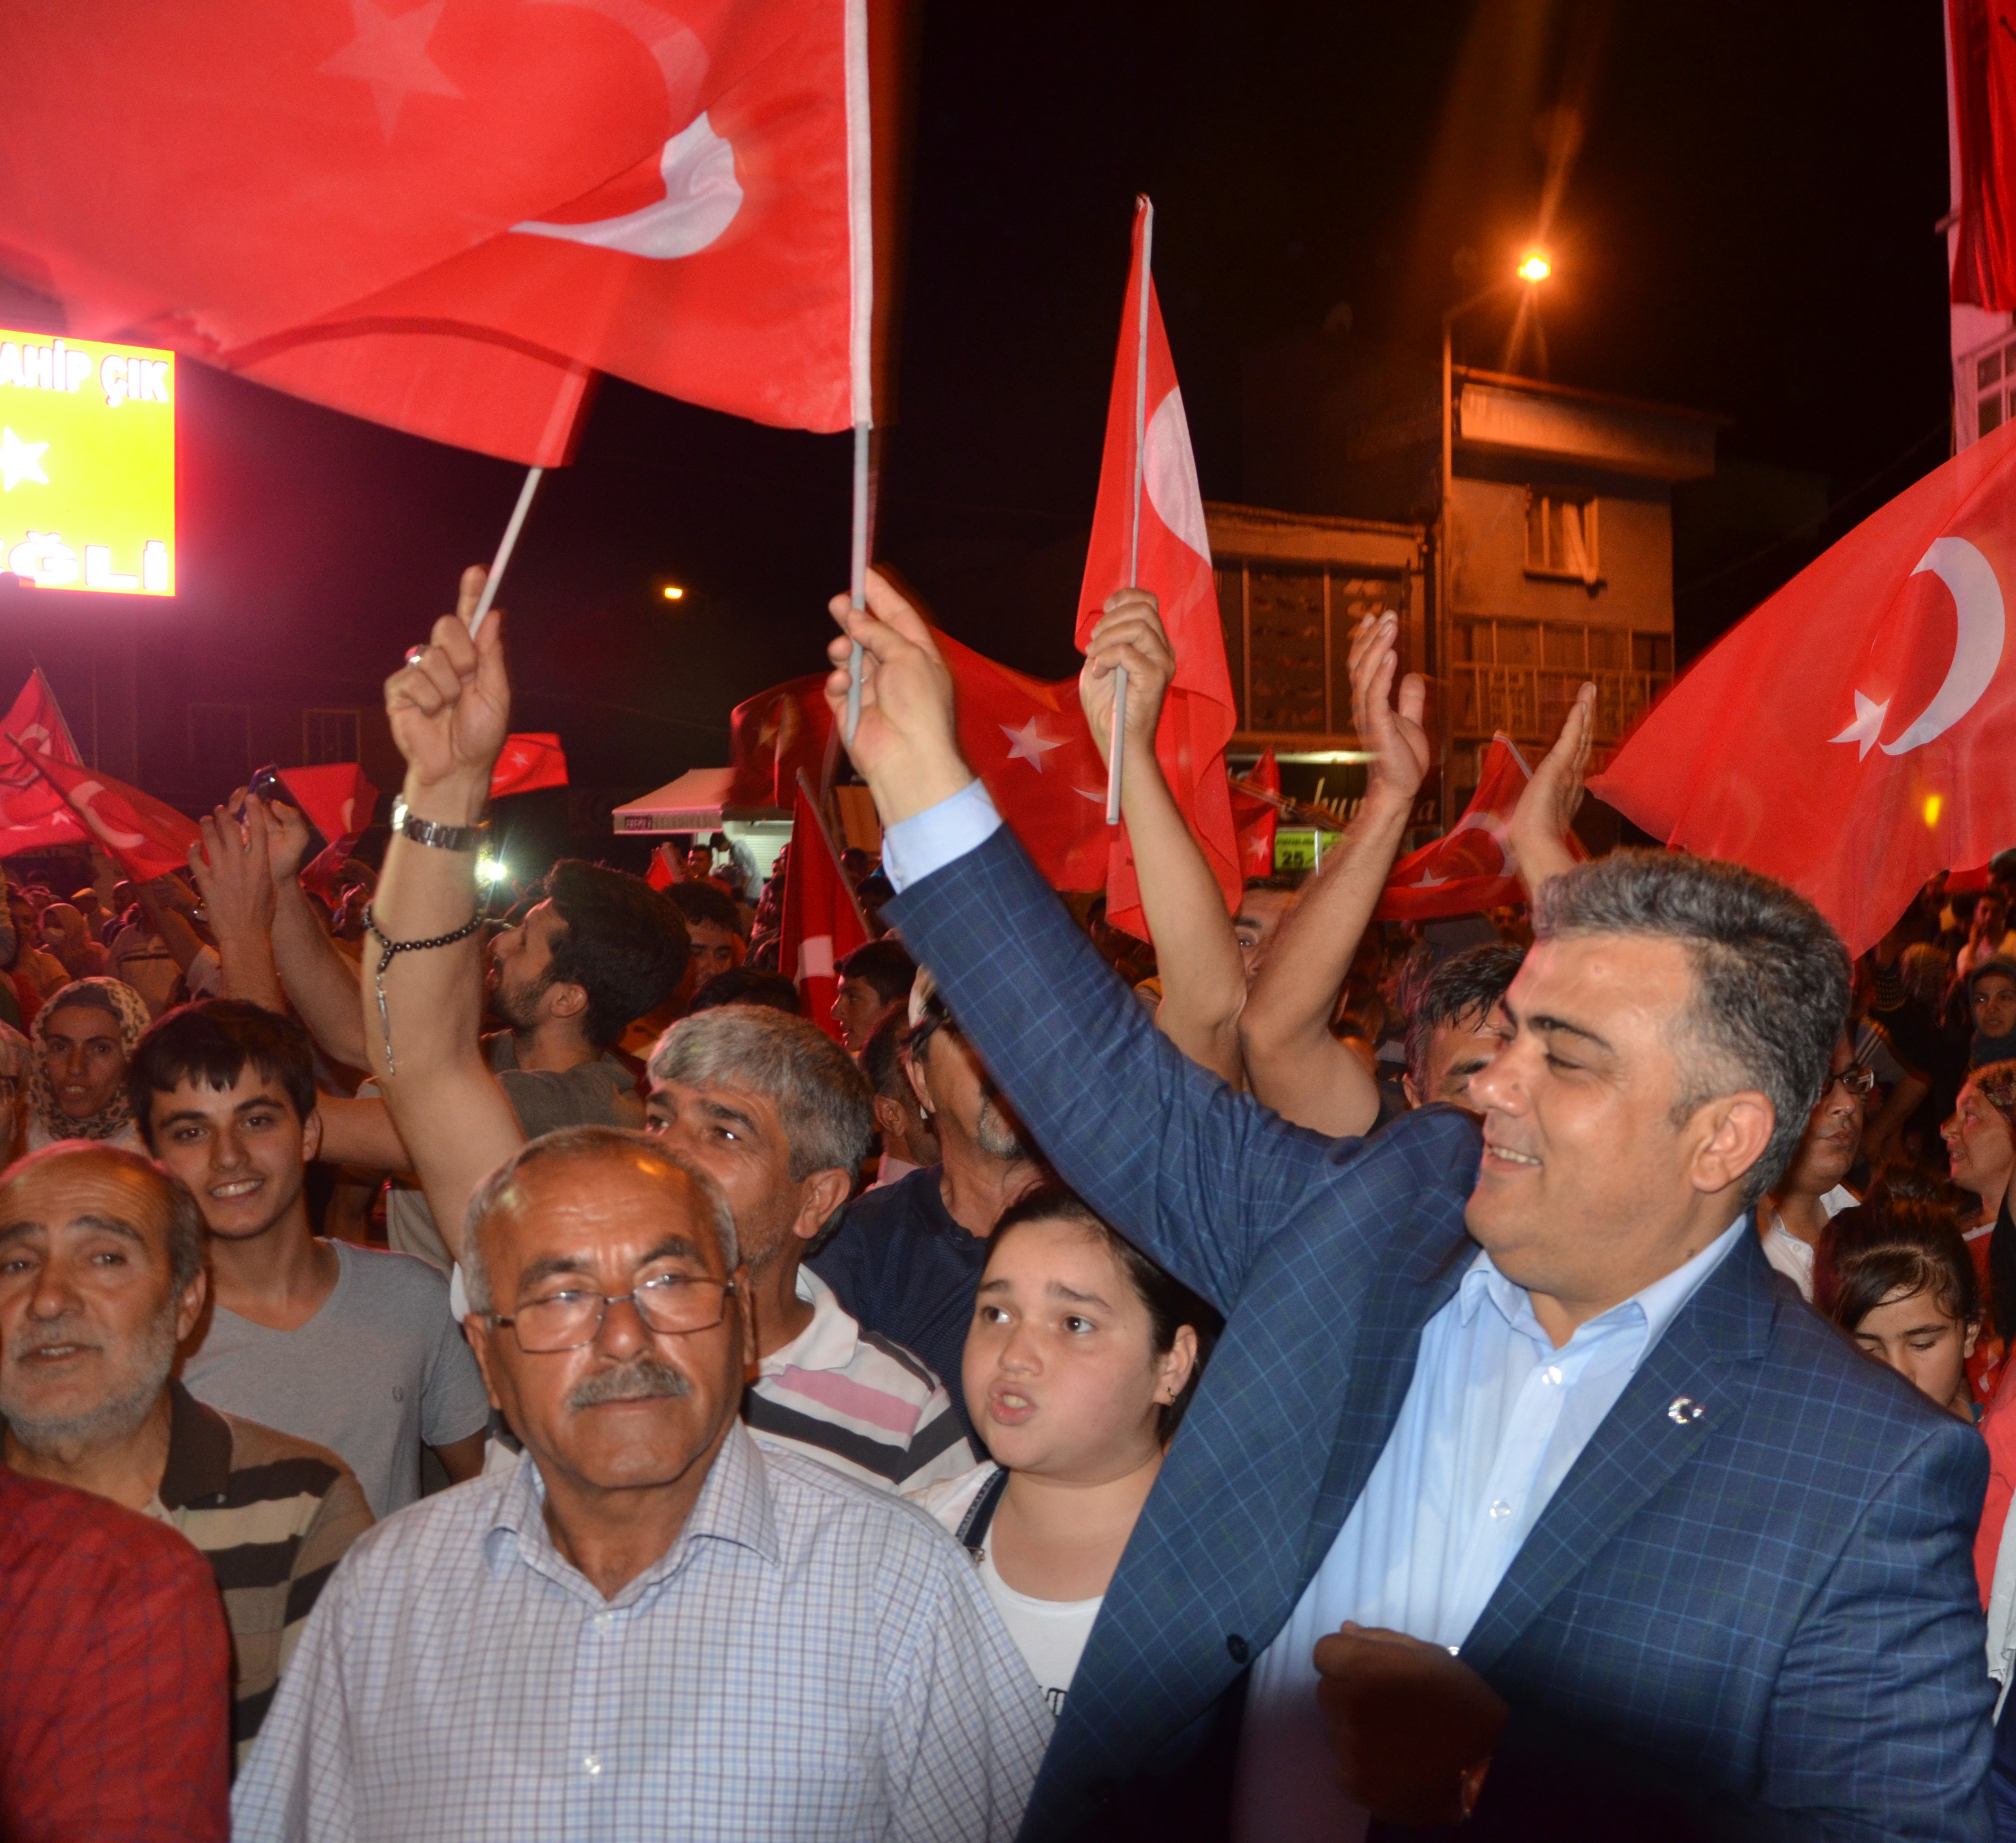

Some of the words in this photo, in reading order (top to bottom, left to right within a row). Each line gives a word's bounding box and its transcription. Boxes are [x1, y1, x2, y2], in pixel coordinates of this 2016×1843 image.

[101, 355, 169, 407] ÇIK
[0, 530, 168, 591] ĞLİ
[1281, 850, 1304, 867] 25
